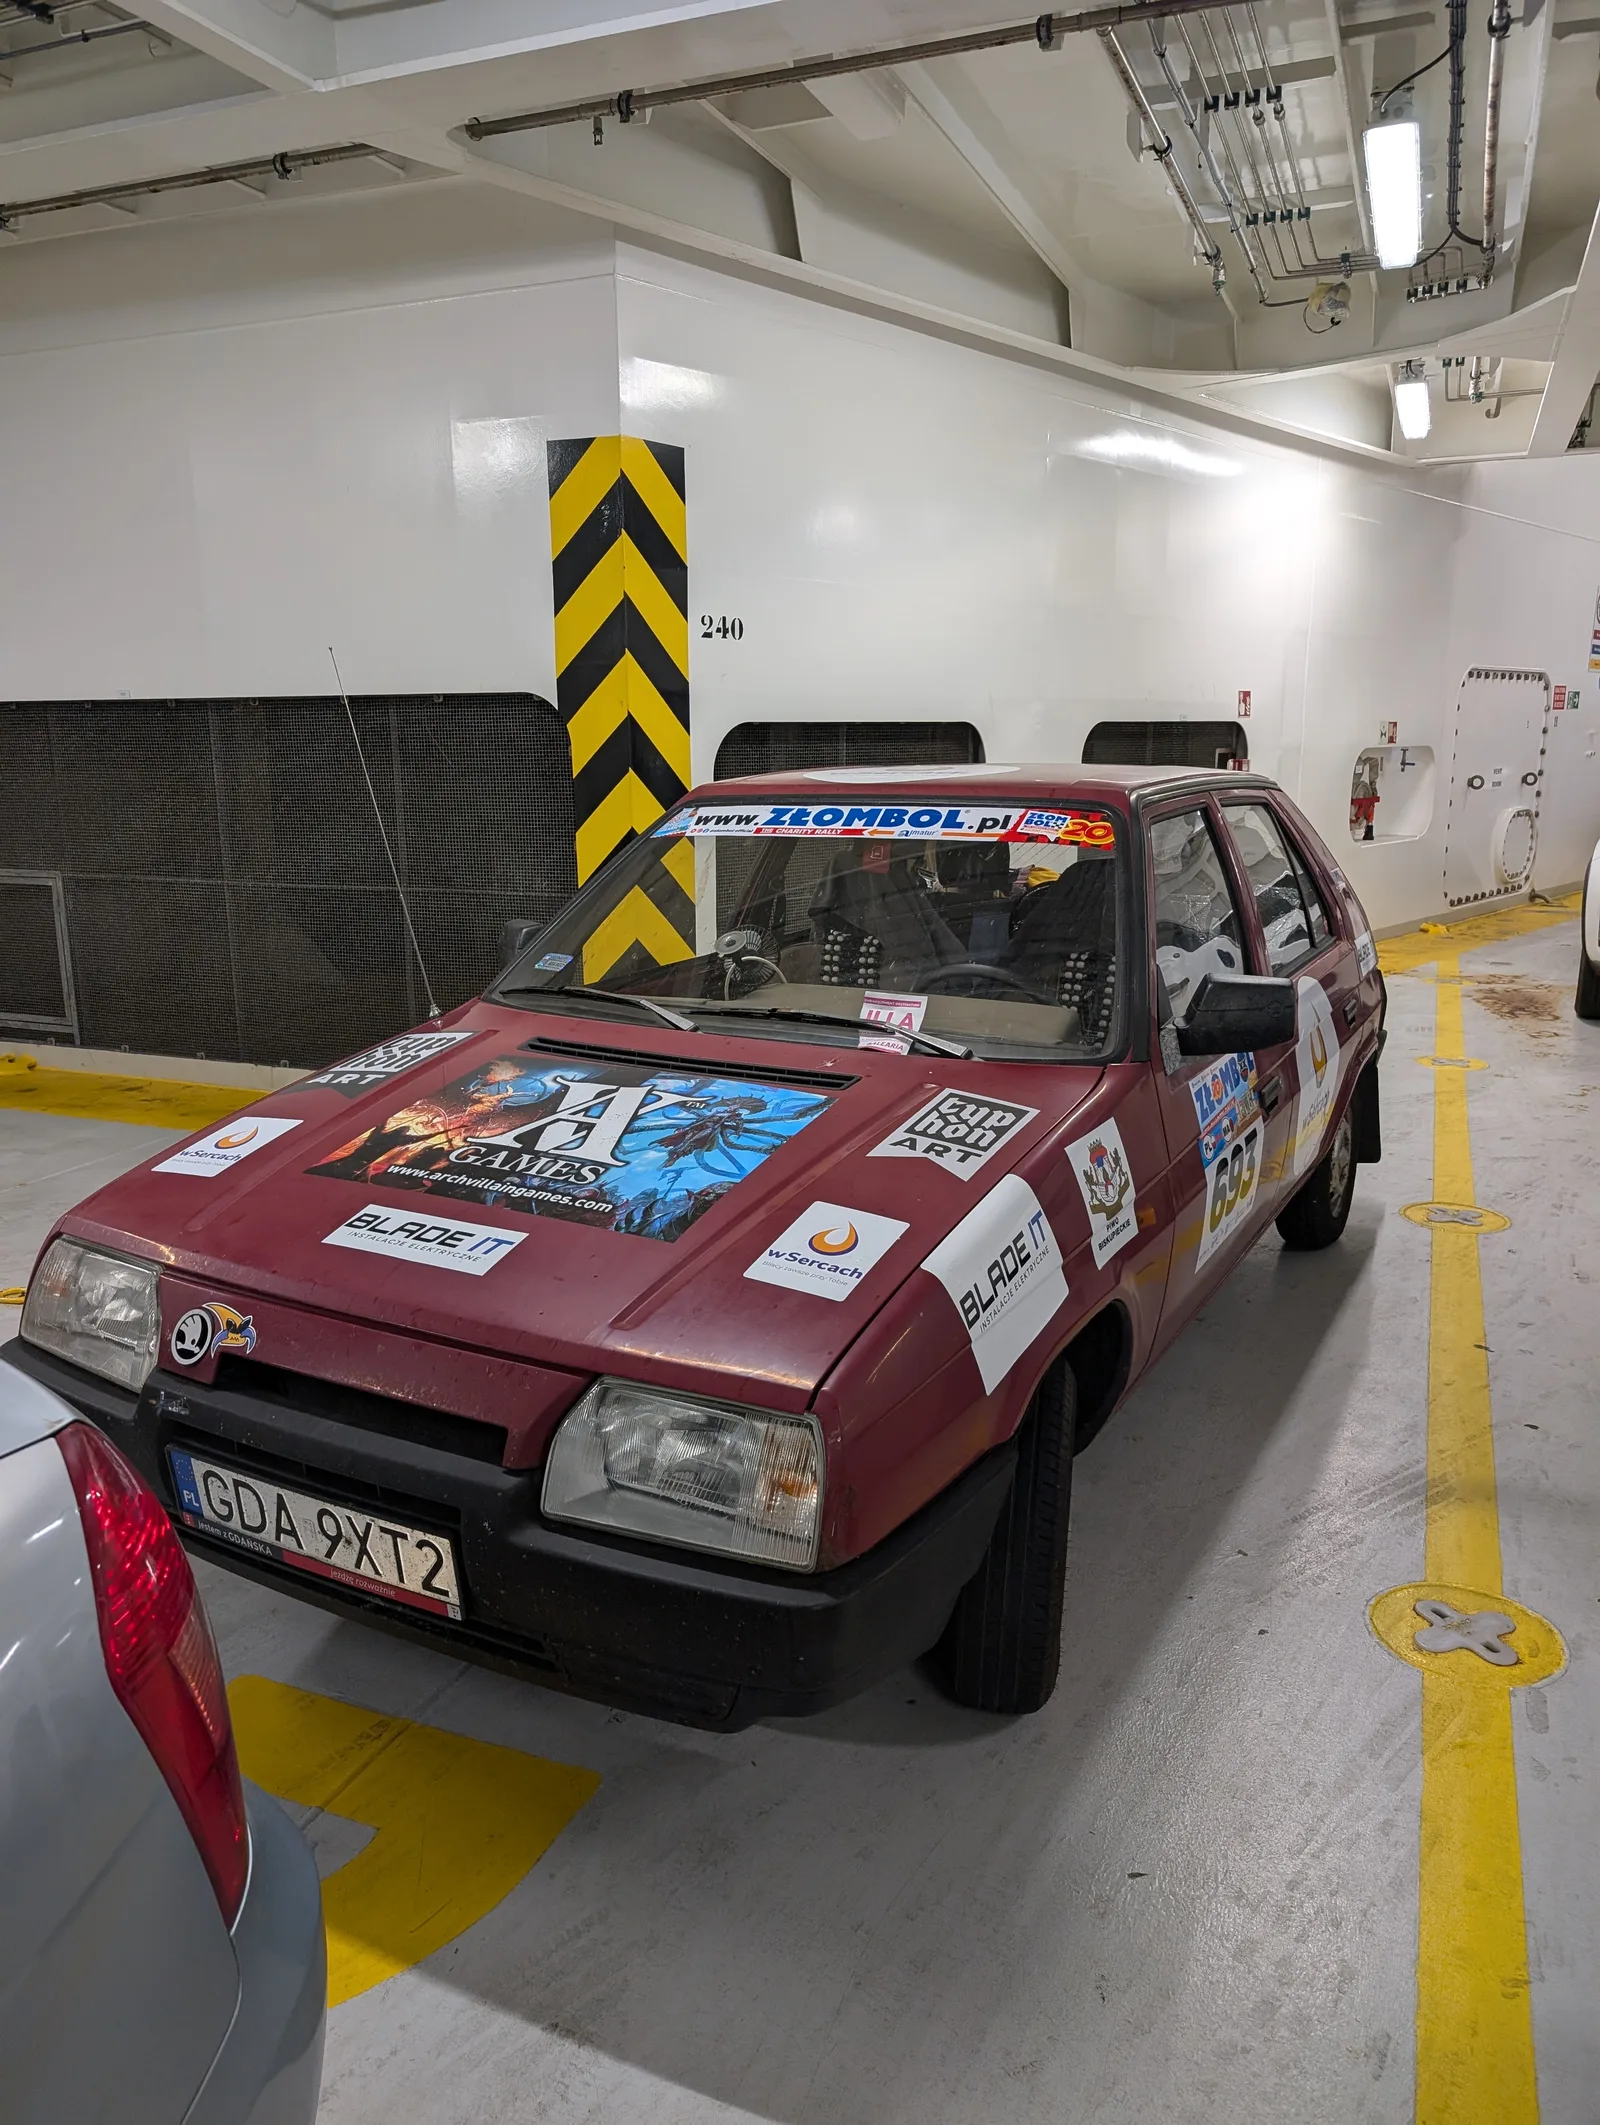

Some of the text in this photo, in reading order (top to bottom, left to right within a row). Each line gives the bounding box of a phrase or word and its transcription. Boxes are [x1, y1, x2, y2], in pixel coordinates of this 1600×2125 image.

[700, 614, 744, 641] 240
[1024, 818, 1052, 828] BOL
[1028, 812, 1068, 822] ZŁOM
[1059, 819, 1115, 845] 20
[305, 1073, 387, 1085] ART
[180, 1149, 242, 1162] wSercach
[888, 1136, 983, 1164] ART
[448, 1145, 607, 1186] GAMES
[1209, 1127, 1258, 1233] 693
[386, 1162, 614, 1214] www.archvillaingames.com
[343, 1212, 516, 1256] BLADE IT
[1097, 1218, 1131, 1251] BISKUPIECKIE
[1105, 1216, 1120, 1232] PIWO
[347, 1231, 483, 1263] INSTALACJE ELEKTRYCZNE
[767, 1248, 864, 1280] wSercach
[783, 1266, 810, 1276] zawsze
[809, 1272, 828, 1281] przy
[828, 1277, 849, 1287] Tobie
[959, 1208, 1047, 1331] BLADE IT
[979, 1245, 1051, 1333] INSTALACJE ELEKTRYCZNE
[182, 1489, 200, 1508] PL
[202, 1469, 450, 1598] GDA 9XT2
